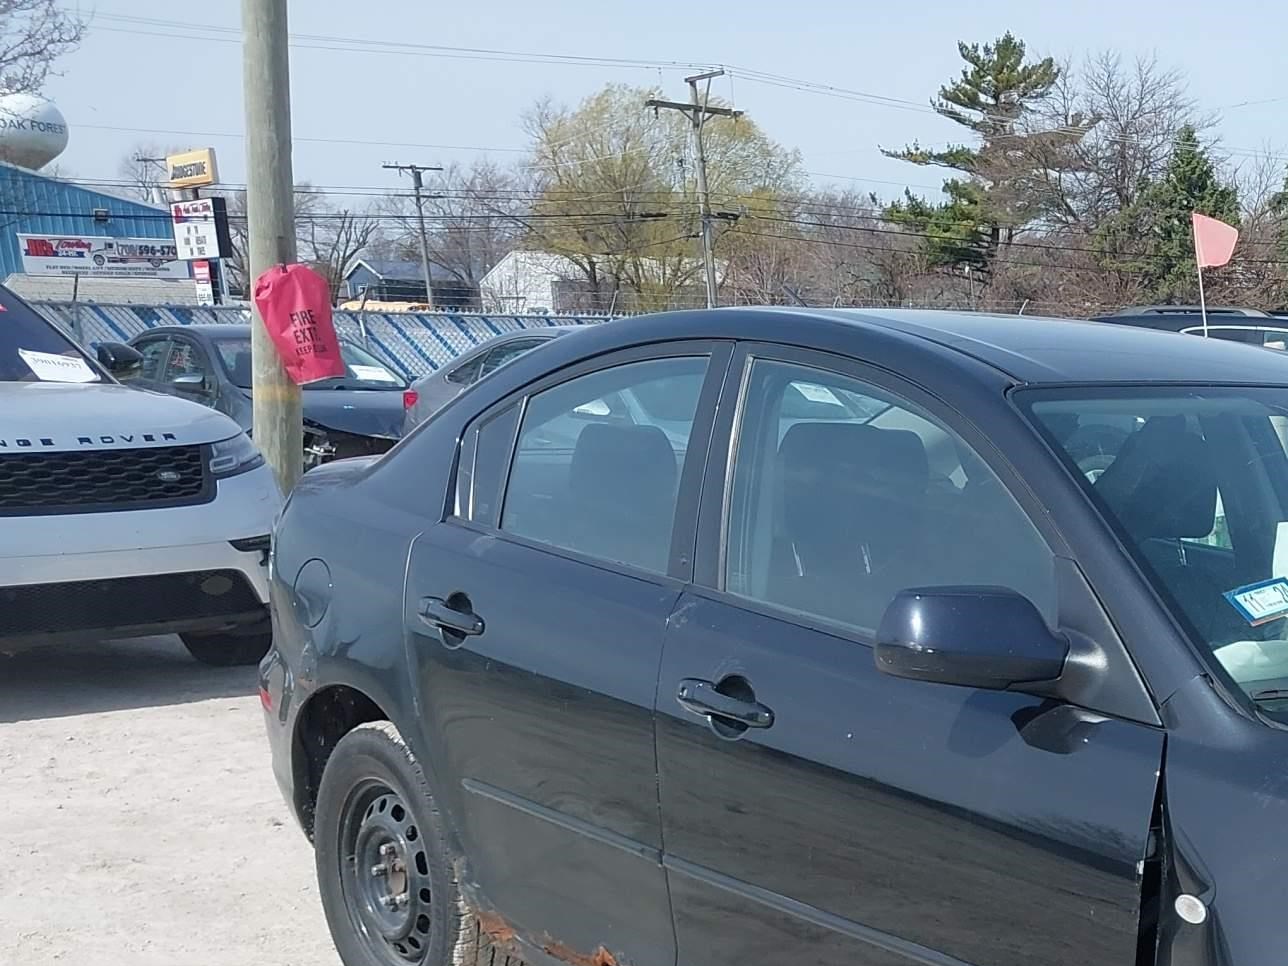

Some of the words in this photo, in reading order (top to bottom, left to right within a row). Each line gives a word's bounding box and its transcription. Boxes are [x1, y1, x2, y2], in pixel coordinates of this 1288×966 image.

[0, 118, 27, 130] OAK
[31, 119, 67, 134] FORES
[138, 245, 177, 256] 596-570
[289, 309, 317, 327] FIRE
[77, 432, 177, 445] ROVER
